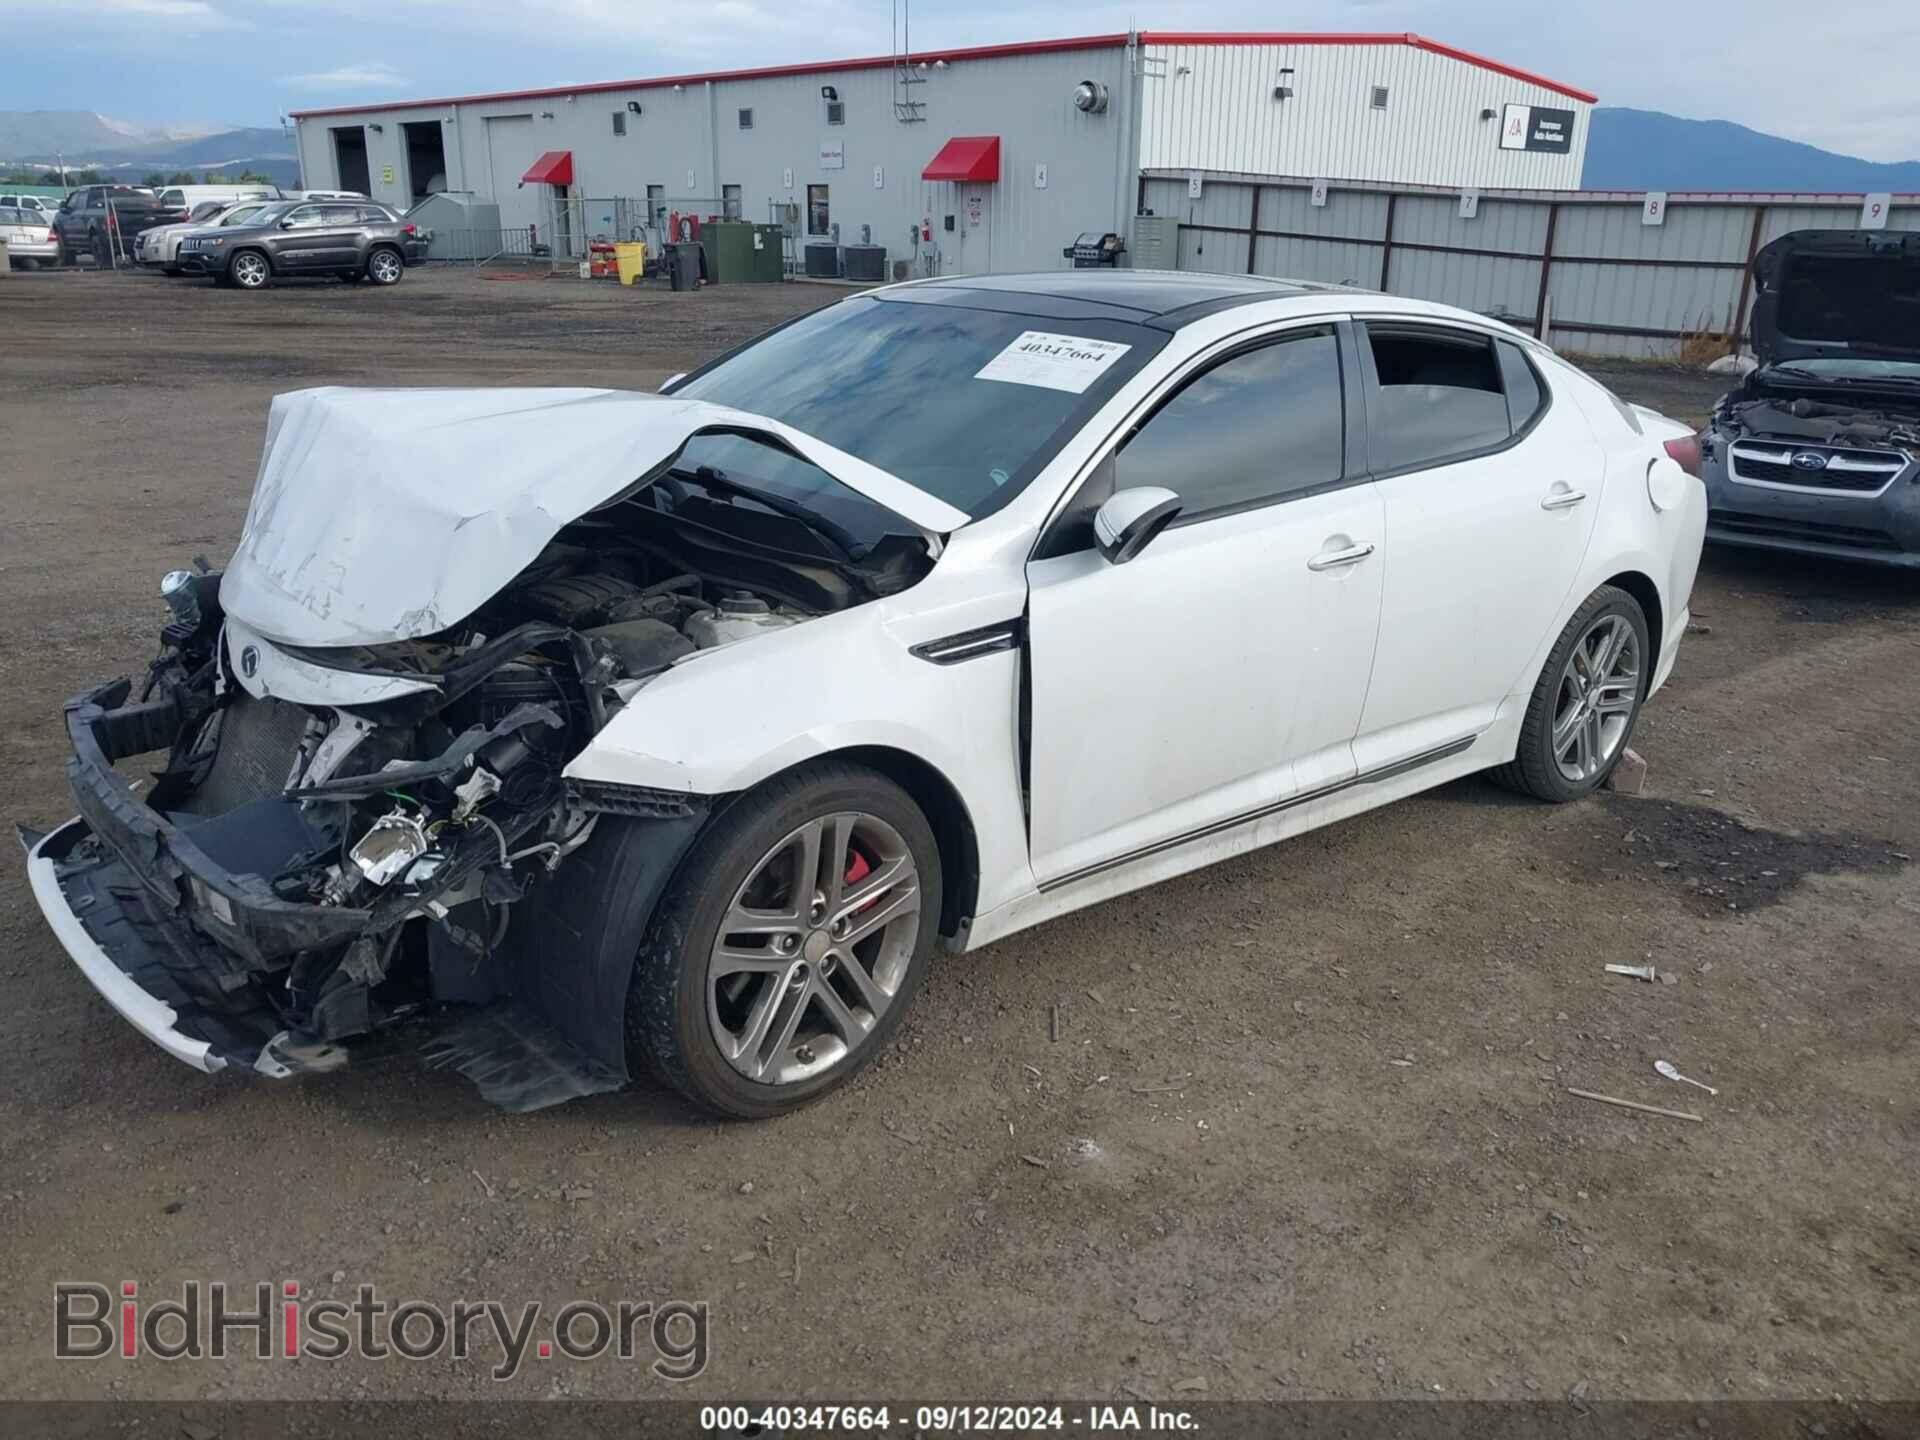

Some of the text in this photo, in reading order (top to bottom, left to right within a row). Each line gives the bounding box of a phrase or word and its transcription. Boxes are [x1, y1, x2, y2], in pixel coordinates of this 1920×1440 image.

[1466, 195, 1473, 208] 7
[1650, 201, 1658, 215] 8
[1872, 203, 1880, 218] 9
[1019, 343, 1105, 361] 40347664
